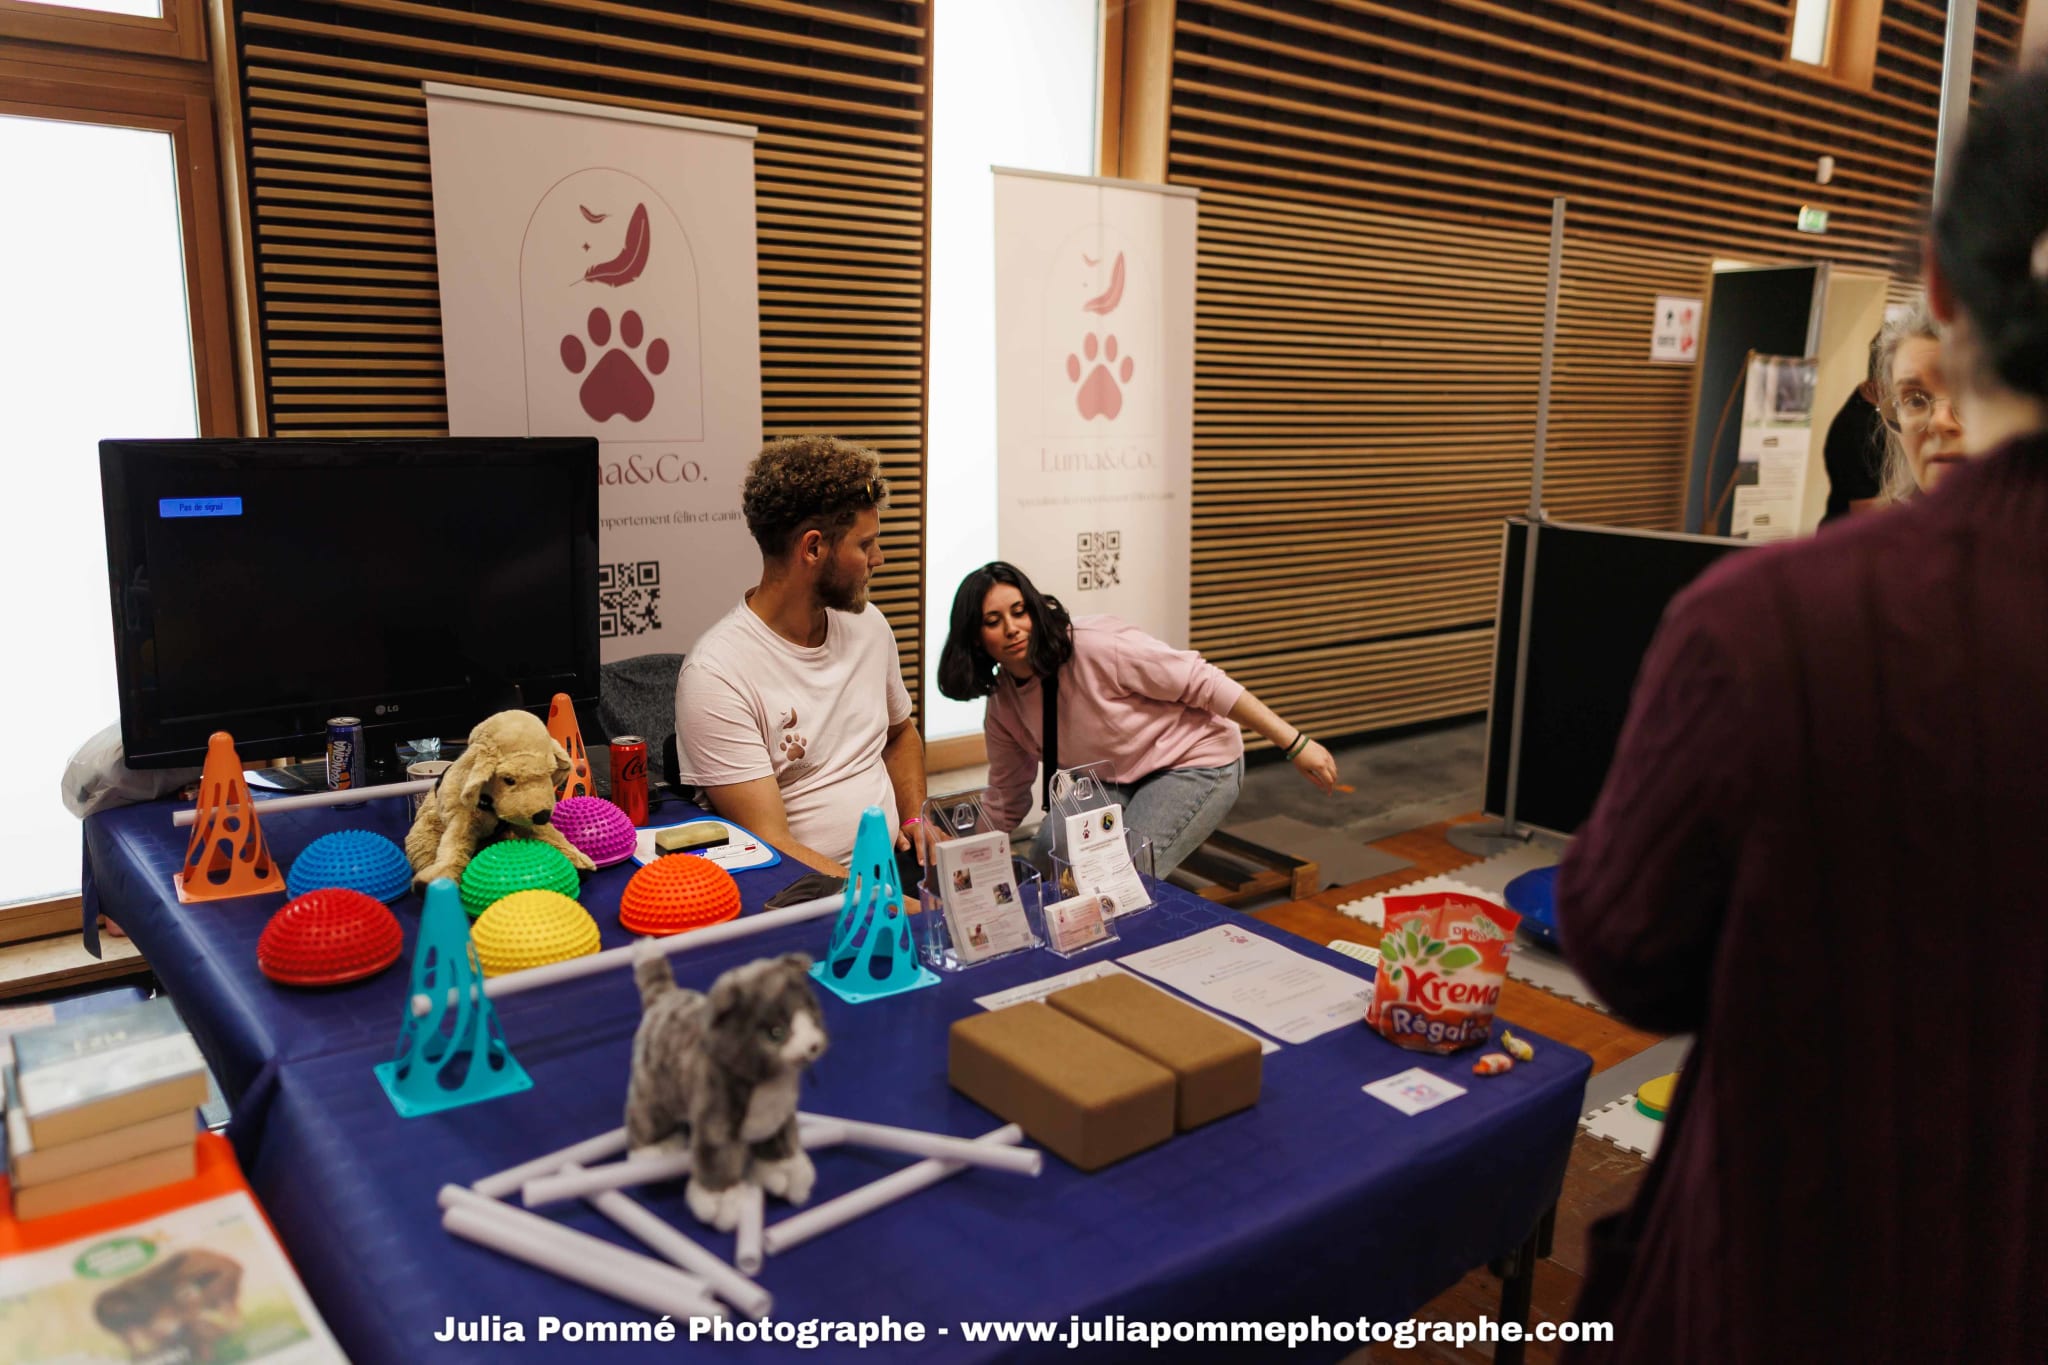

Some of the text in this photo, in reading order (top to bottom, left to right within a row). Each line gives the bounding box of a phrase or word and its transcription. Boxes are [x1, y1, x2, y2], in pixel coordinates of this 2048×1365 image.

[1040, 446, 1161, 473] Luma&Co.
[698, 511, 709, 523] et
[387, 704, 399, 713] LG
[328, 740, 349, 790] ORANGINA
